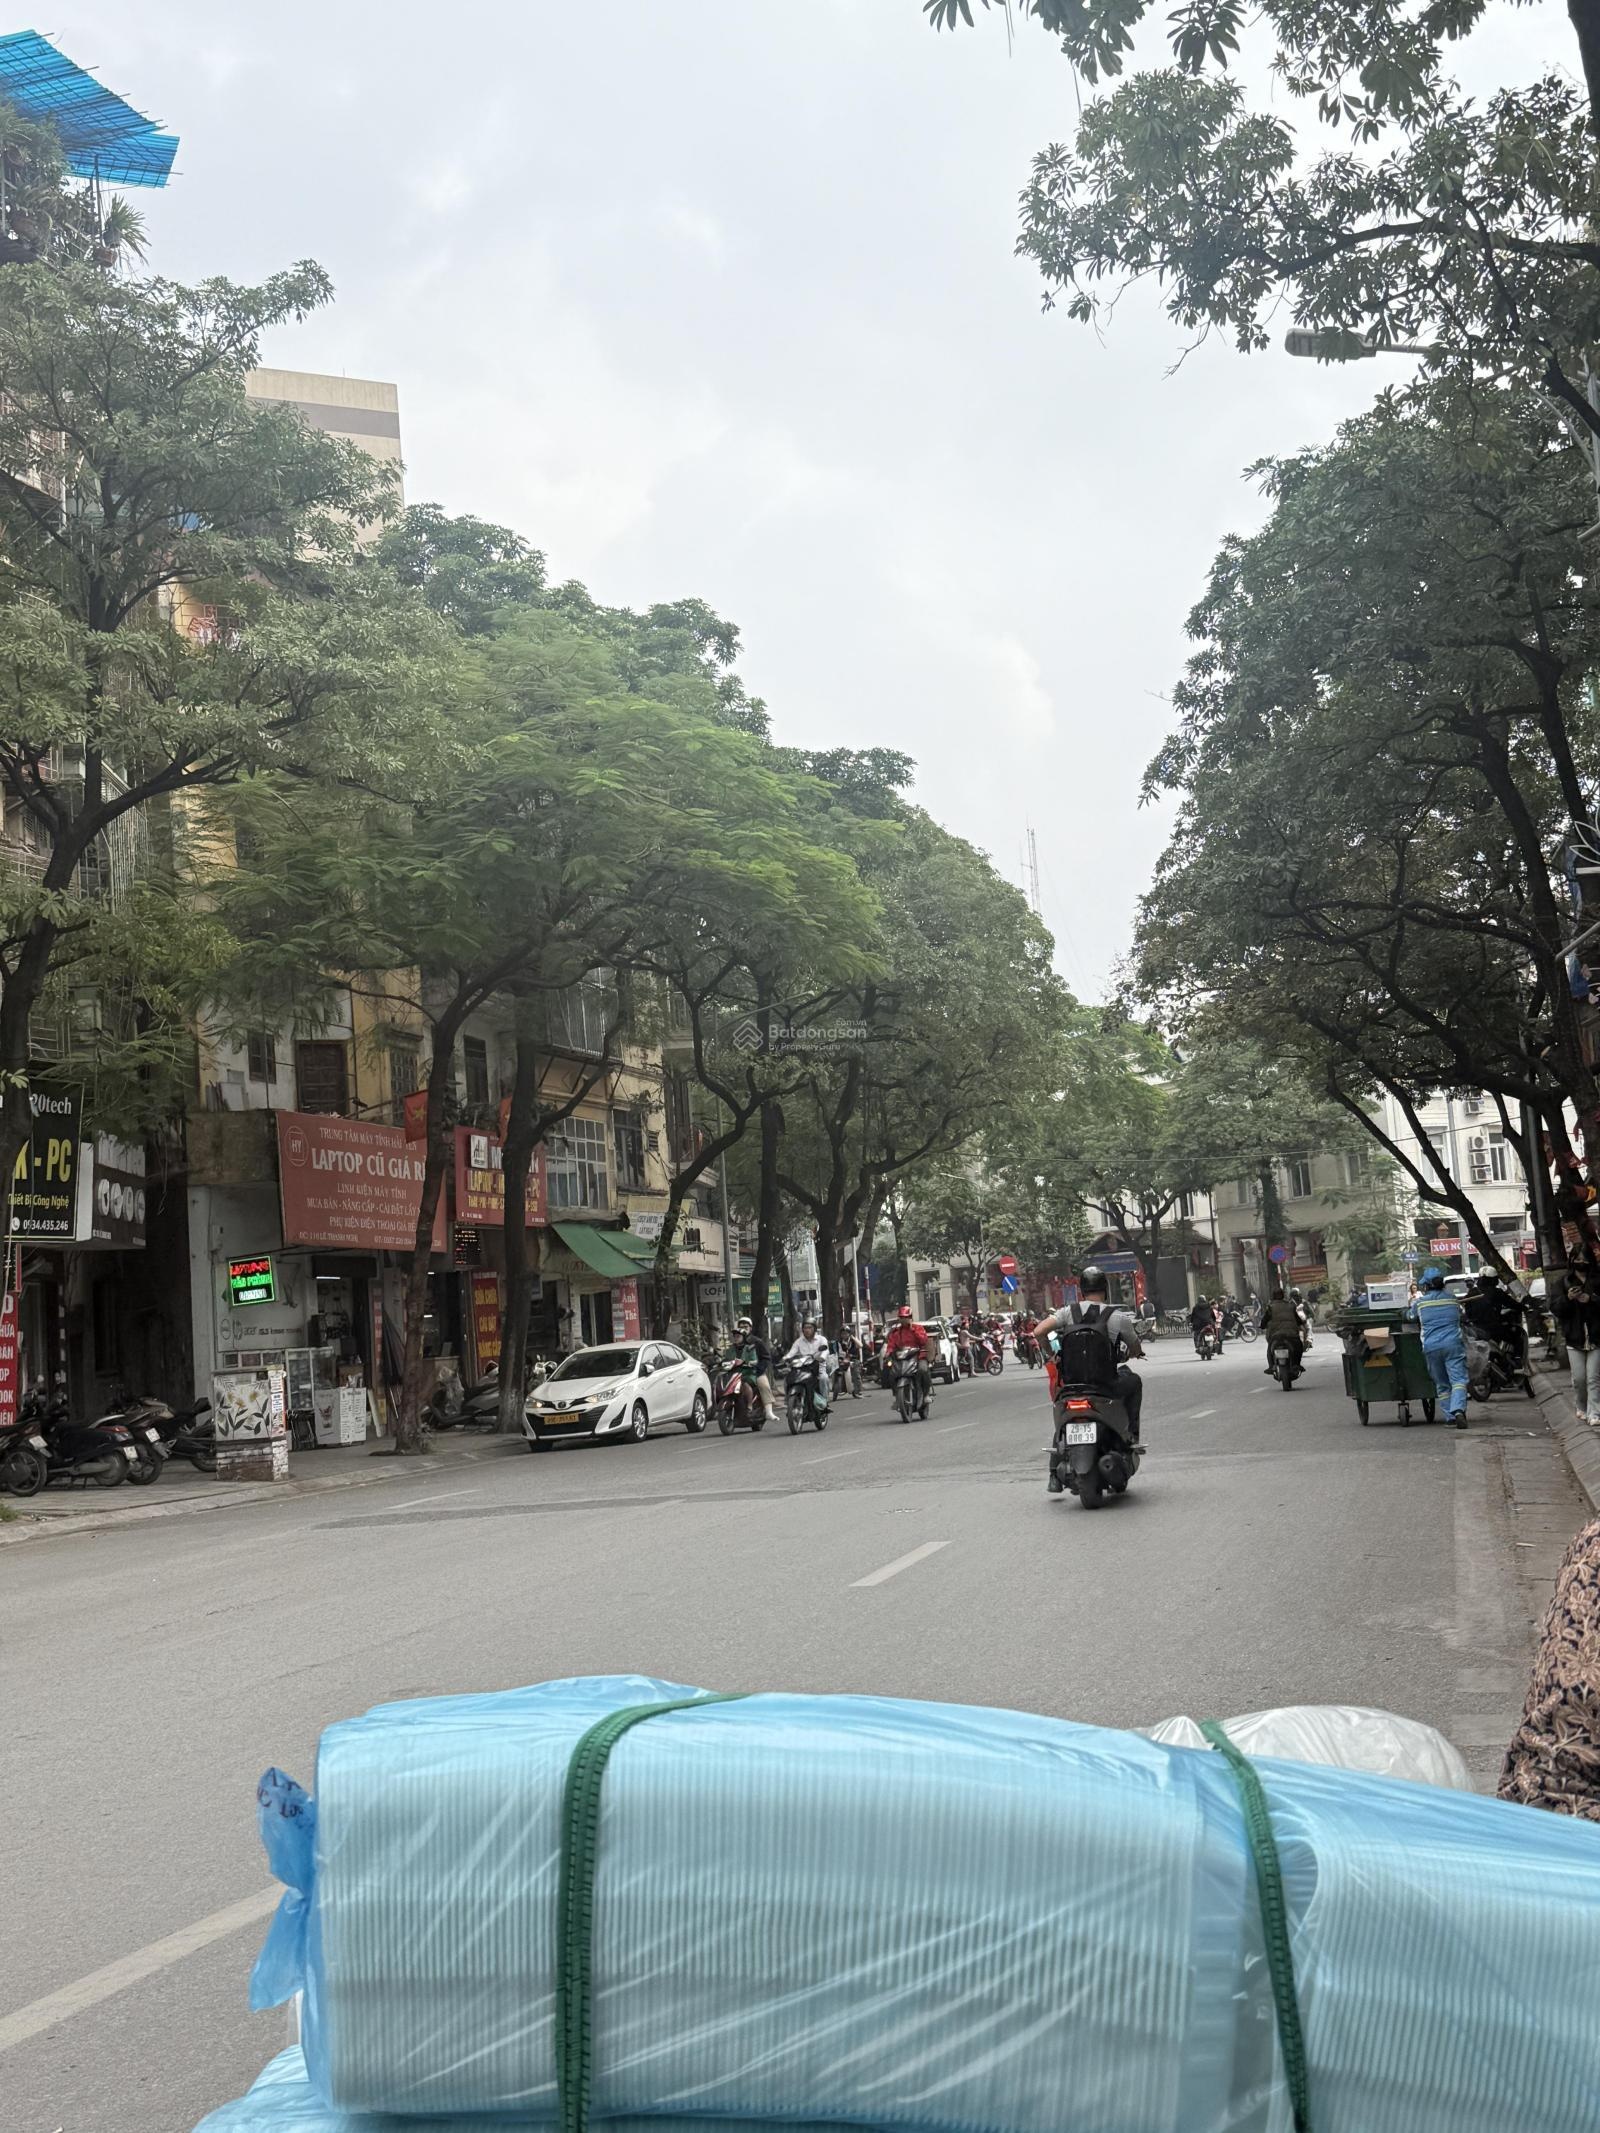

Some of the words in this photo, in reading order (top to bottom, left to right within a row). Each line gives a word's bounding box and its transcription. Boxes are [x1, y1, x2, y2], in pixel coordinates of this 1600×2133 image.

[319, 1127, 343, 1140] TRUNG
[46, 1138, 72, 1182] PC
[311, 1147, 363, 1175] LAPTOP
[367, 1151, 385, 1176] CŨ
[388, 1155, 411, 1180] GIÁ
